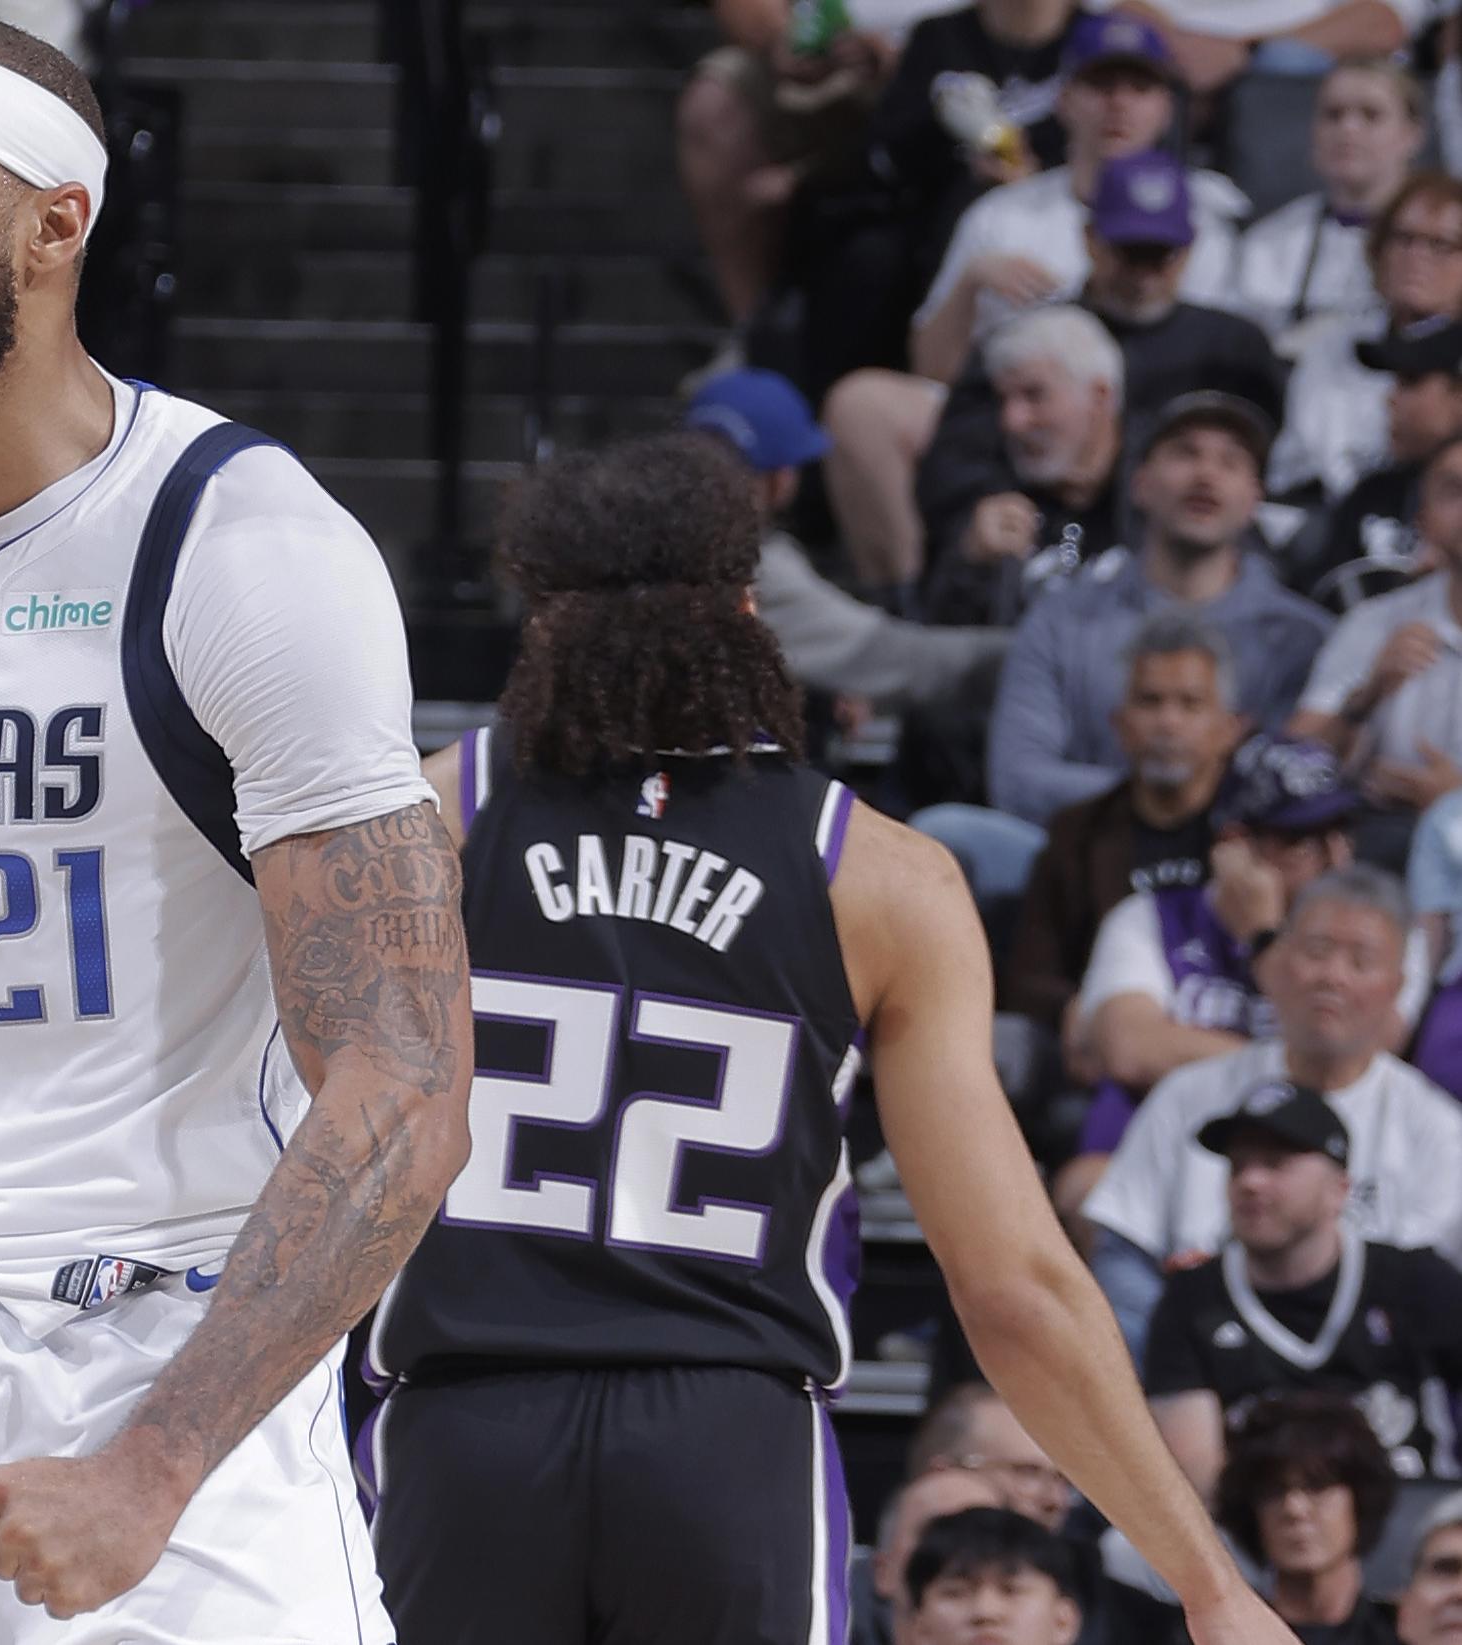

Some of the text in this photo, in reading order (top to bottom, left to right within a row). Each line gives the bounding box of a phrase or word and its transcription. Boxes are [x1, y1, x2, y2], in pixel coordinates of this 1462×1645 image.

[5, 594, 113, 631] chime
[524, 834, 765, 952] CARTER
[440, 969, 803, 1268] 22
